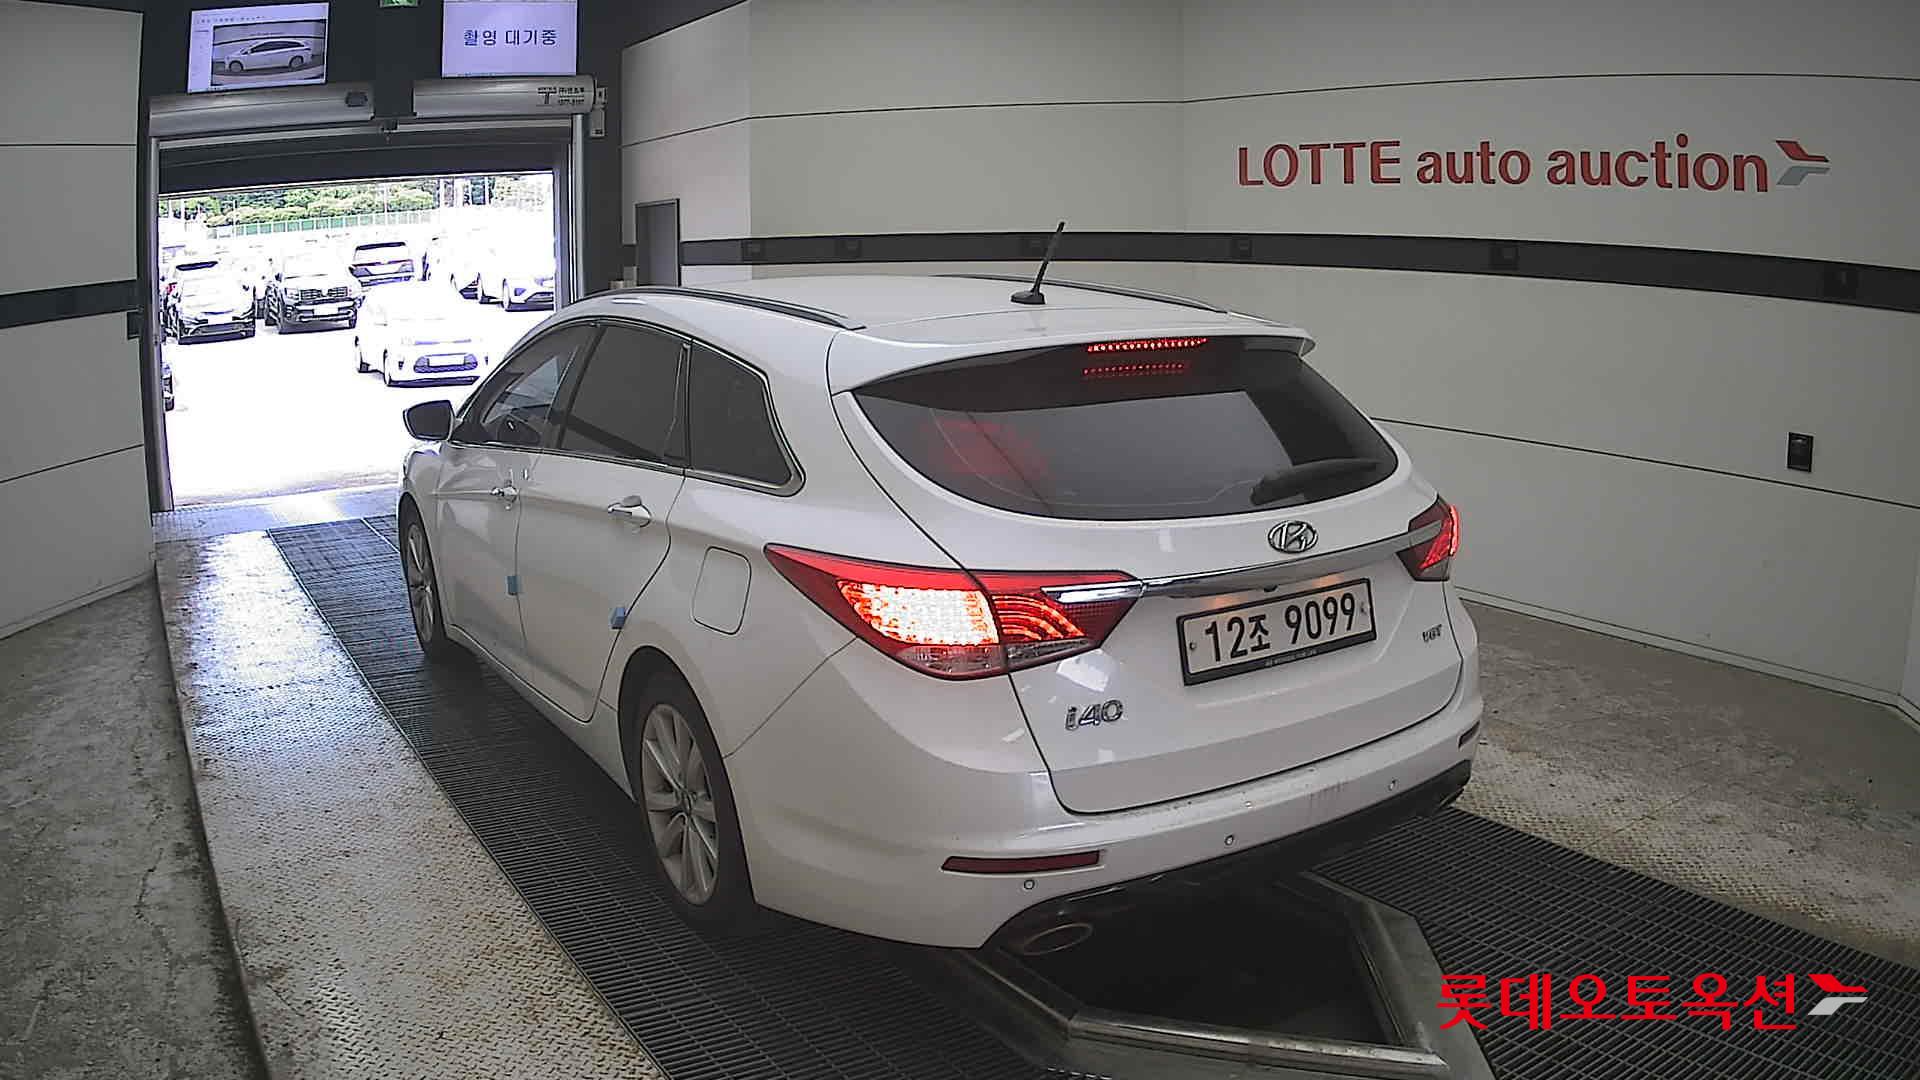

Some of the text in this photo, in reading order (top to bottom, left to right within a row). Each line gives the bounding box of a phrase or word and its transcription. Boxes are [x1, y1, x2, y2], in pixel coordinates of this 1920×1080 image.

[505, 29, 557, 46] 대기중
[1238, 133, 1768, 192] LOTTE auto auction
[1205, 593, 1355, 662] 12조 9099
[1065, 699, 1123, 731] i40
